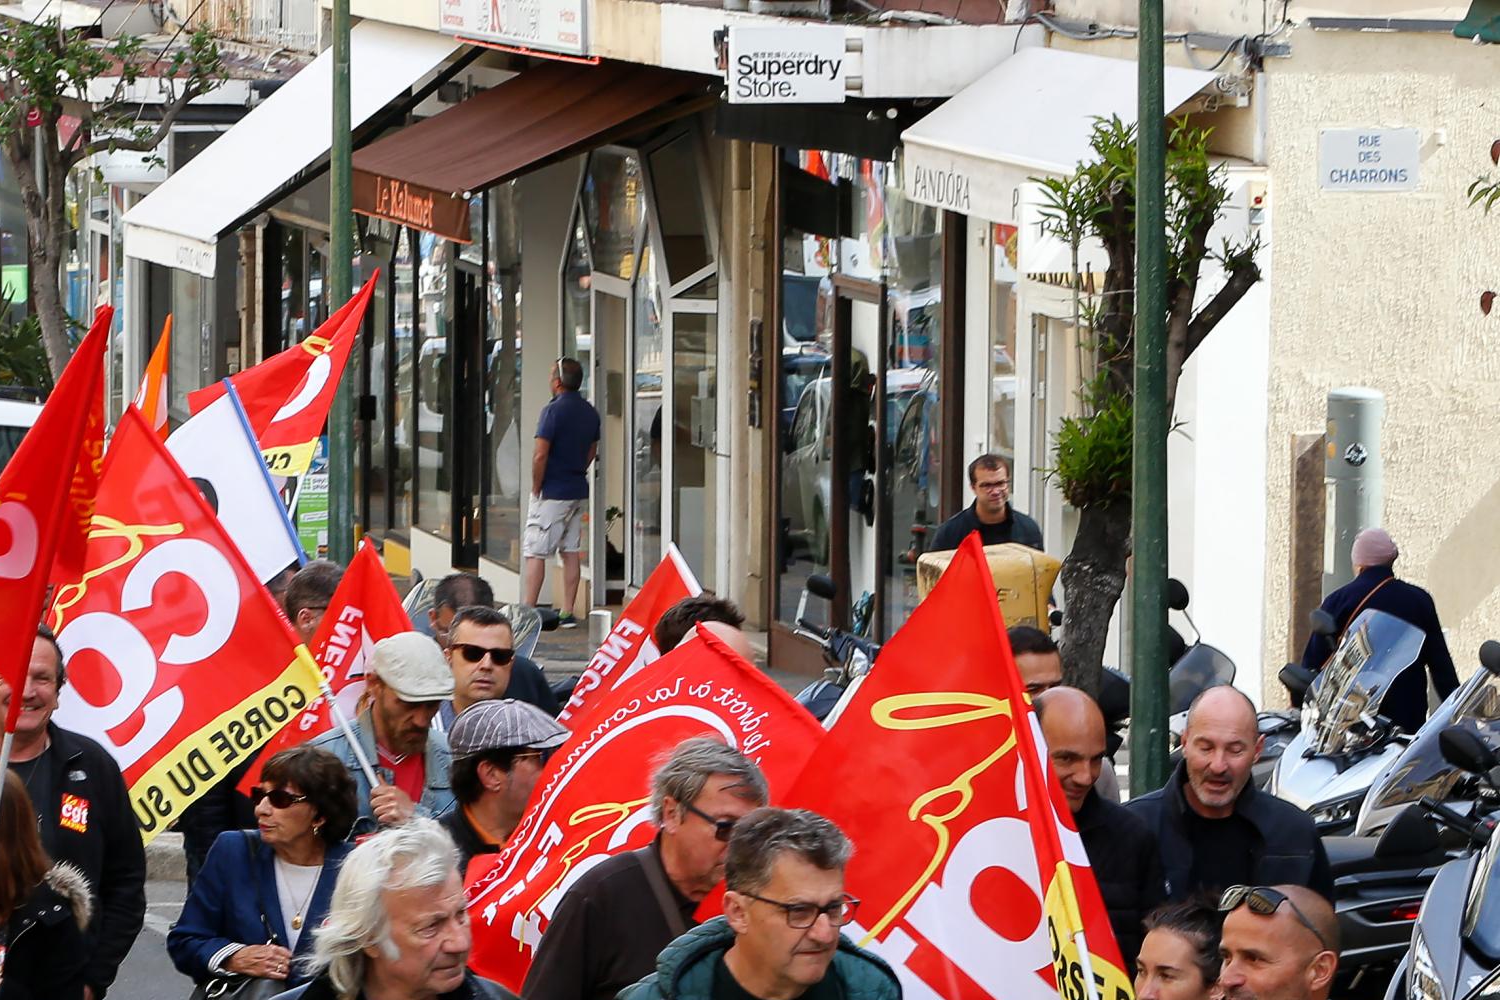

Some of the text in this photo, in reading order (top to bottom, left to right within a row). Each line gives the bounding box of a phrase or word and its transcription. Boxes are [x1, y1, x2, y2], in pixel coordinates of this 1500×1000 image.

[738, 55, 842, 80] Superdry
[737, 76, 796, 97] Store.
[1358, 135, 1381, 147] RUE
[1358, 151, 1381, 162] DES
[1330, 169, 1408, 183] CHARRONS
[61, 803, 88, 825] cgt
